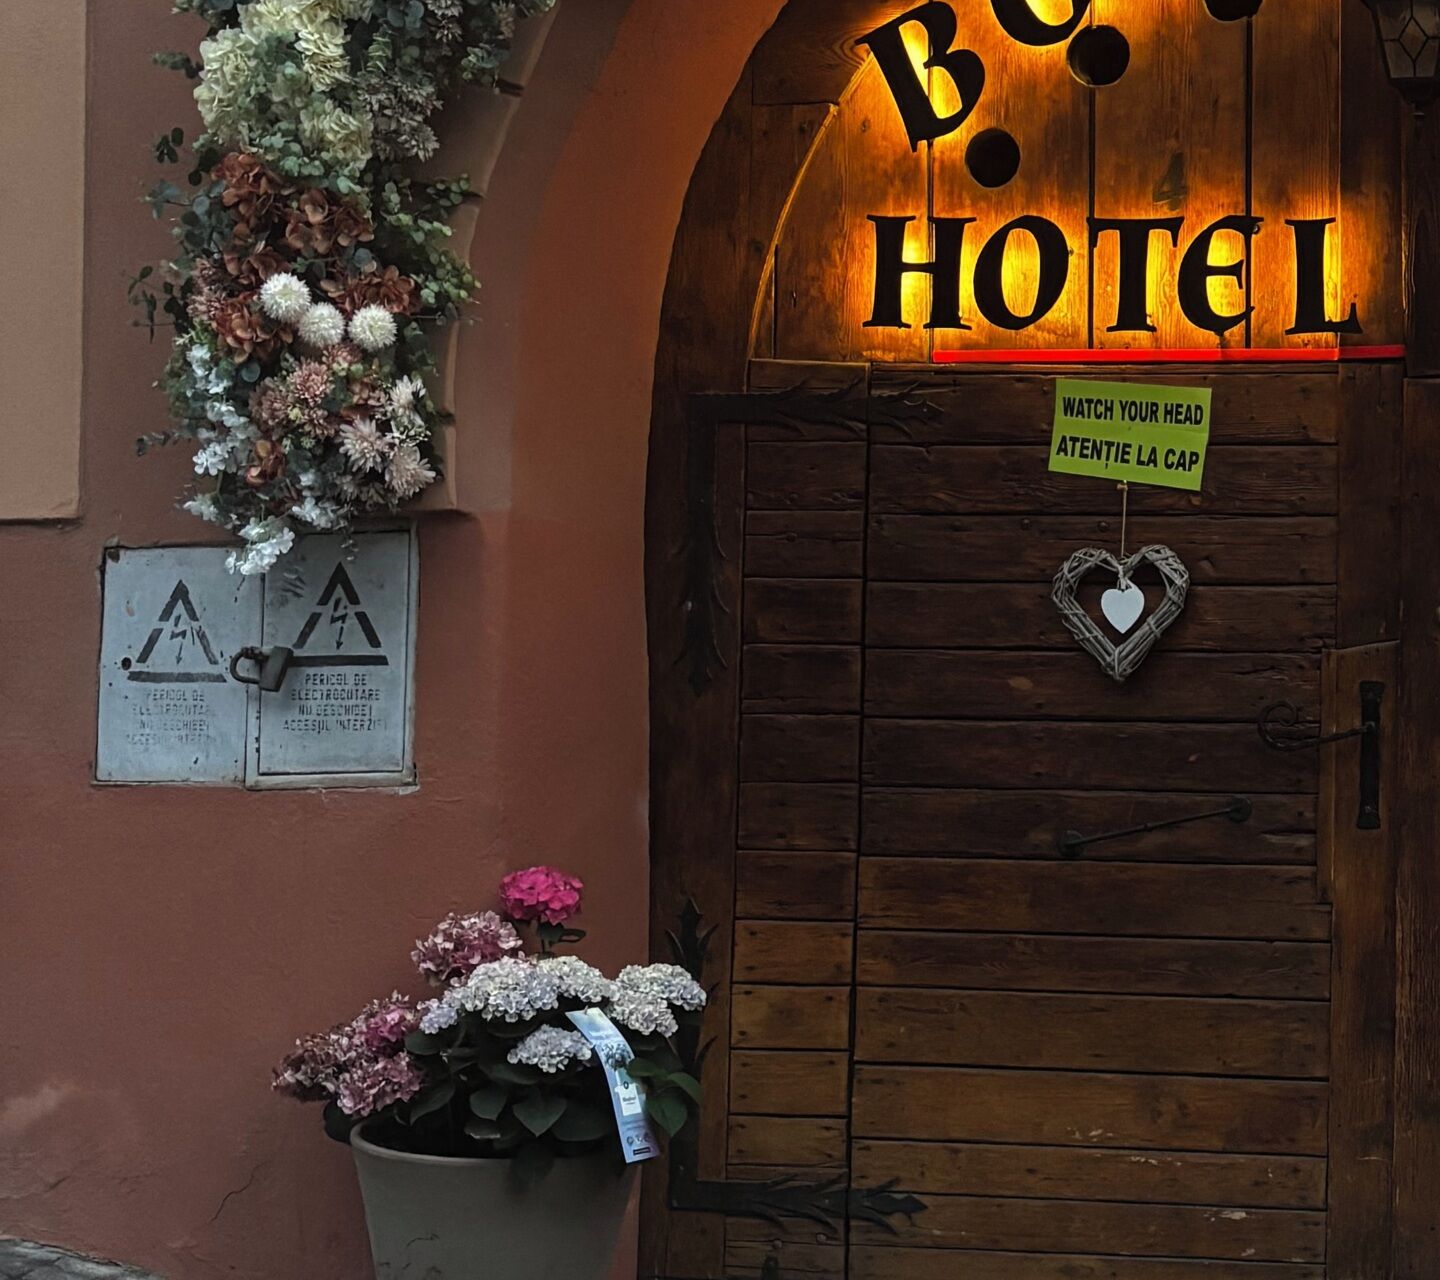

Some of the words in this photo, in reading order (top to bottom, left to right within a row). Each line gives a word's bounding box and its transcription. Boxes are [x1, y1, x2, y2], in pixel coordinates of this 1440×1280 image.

[862, 214, 1363, 335] HOTEL
[1062, 396, 1114, 421] WATCH
[1119, 399, 1159, 423] YOUR
[1163, 402, 1204, 425] HEAD
[1135, 444, 1159, 468] LA
[1164, 447, 1200, 472] CAP
[353, 673, 368, 686] DE
